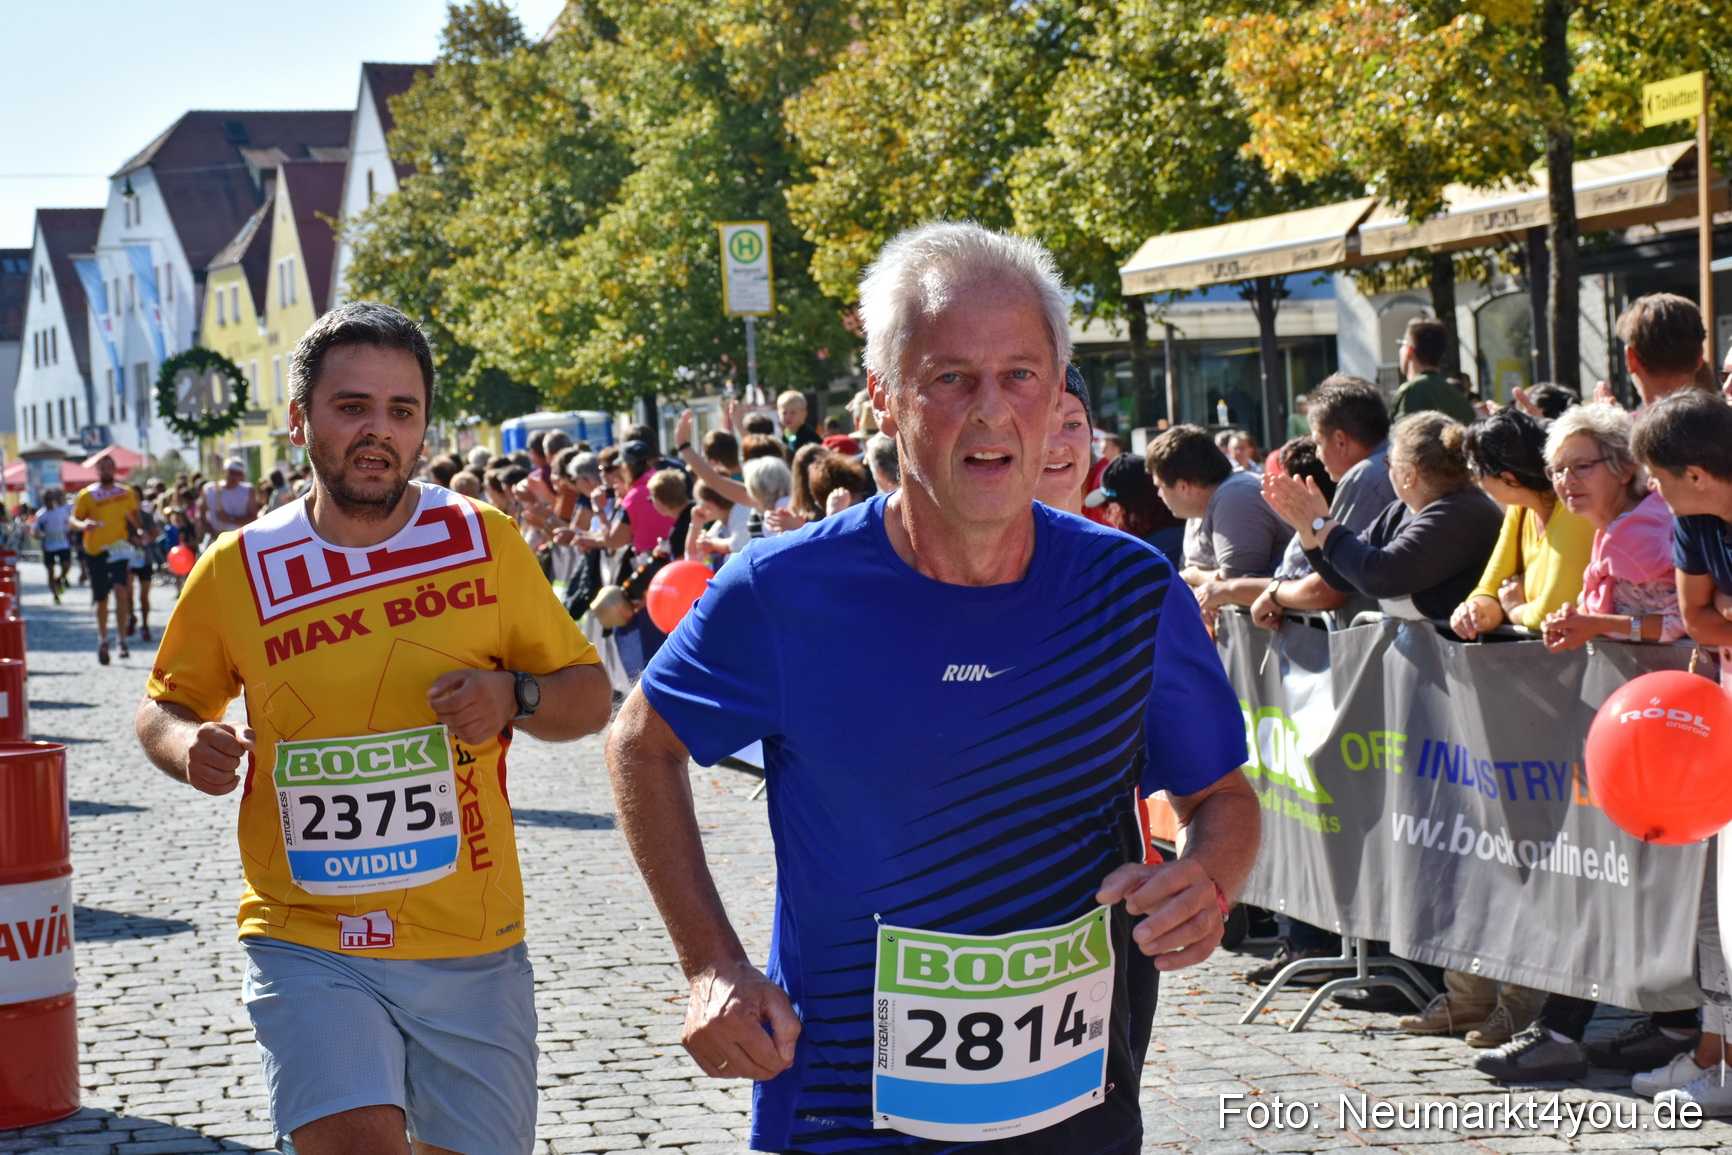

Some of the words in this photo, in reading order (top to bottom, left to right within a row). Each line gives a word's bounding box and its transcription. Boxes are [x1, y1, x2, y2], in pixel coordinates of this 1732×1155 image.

[1655, 90, 1699, 112] Toiletten
[175, 366, 230, 413] 20
[263, 608, 372, 667] MAX
[383, 577, 498, 628] BÖGL
[941, 664, 987, 682] RUN
[1620, 696, 1711, 731] RÖDL
[1666, 720, 1709, 738] energie
[286, 735, 437, 781] BOCK
[299, 784, 436, 840] 2375
[438, 785, 447, 794] C
[324, 849, 418, 877] OVIDIU
[896, 922, 1100, 991] BOCK
[905, 991, 1087, 1071] 2814
[805, 1114, 836, 1127] DRI-FIT
